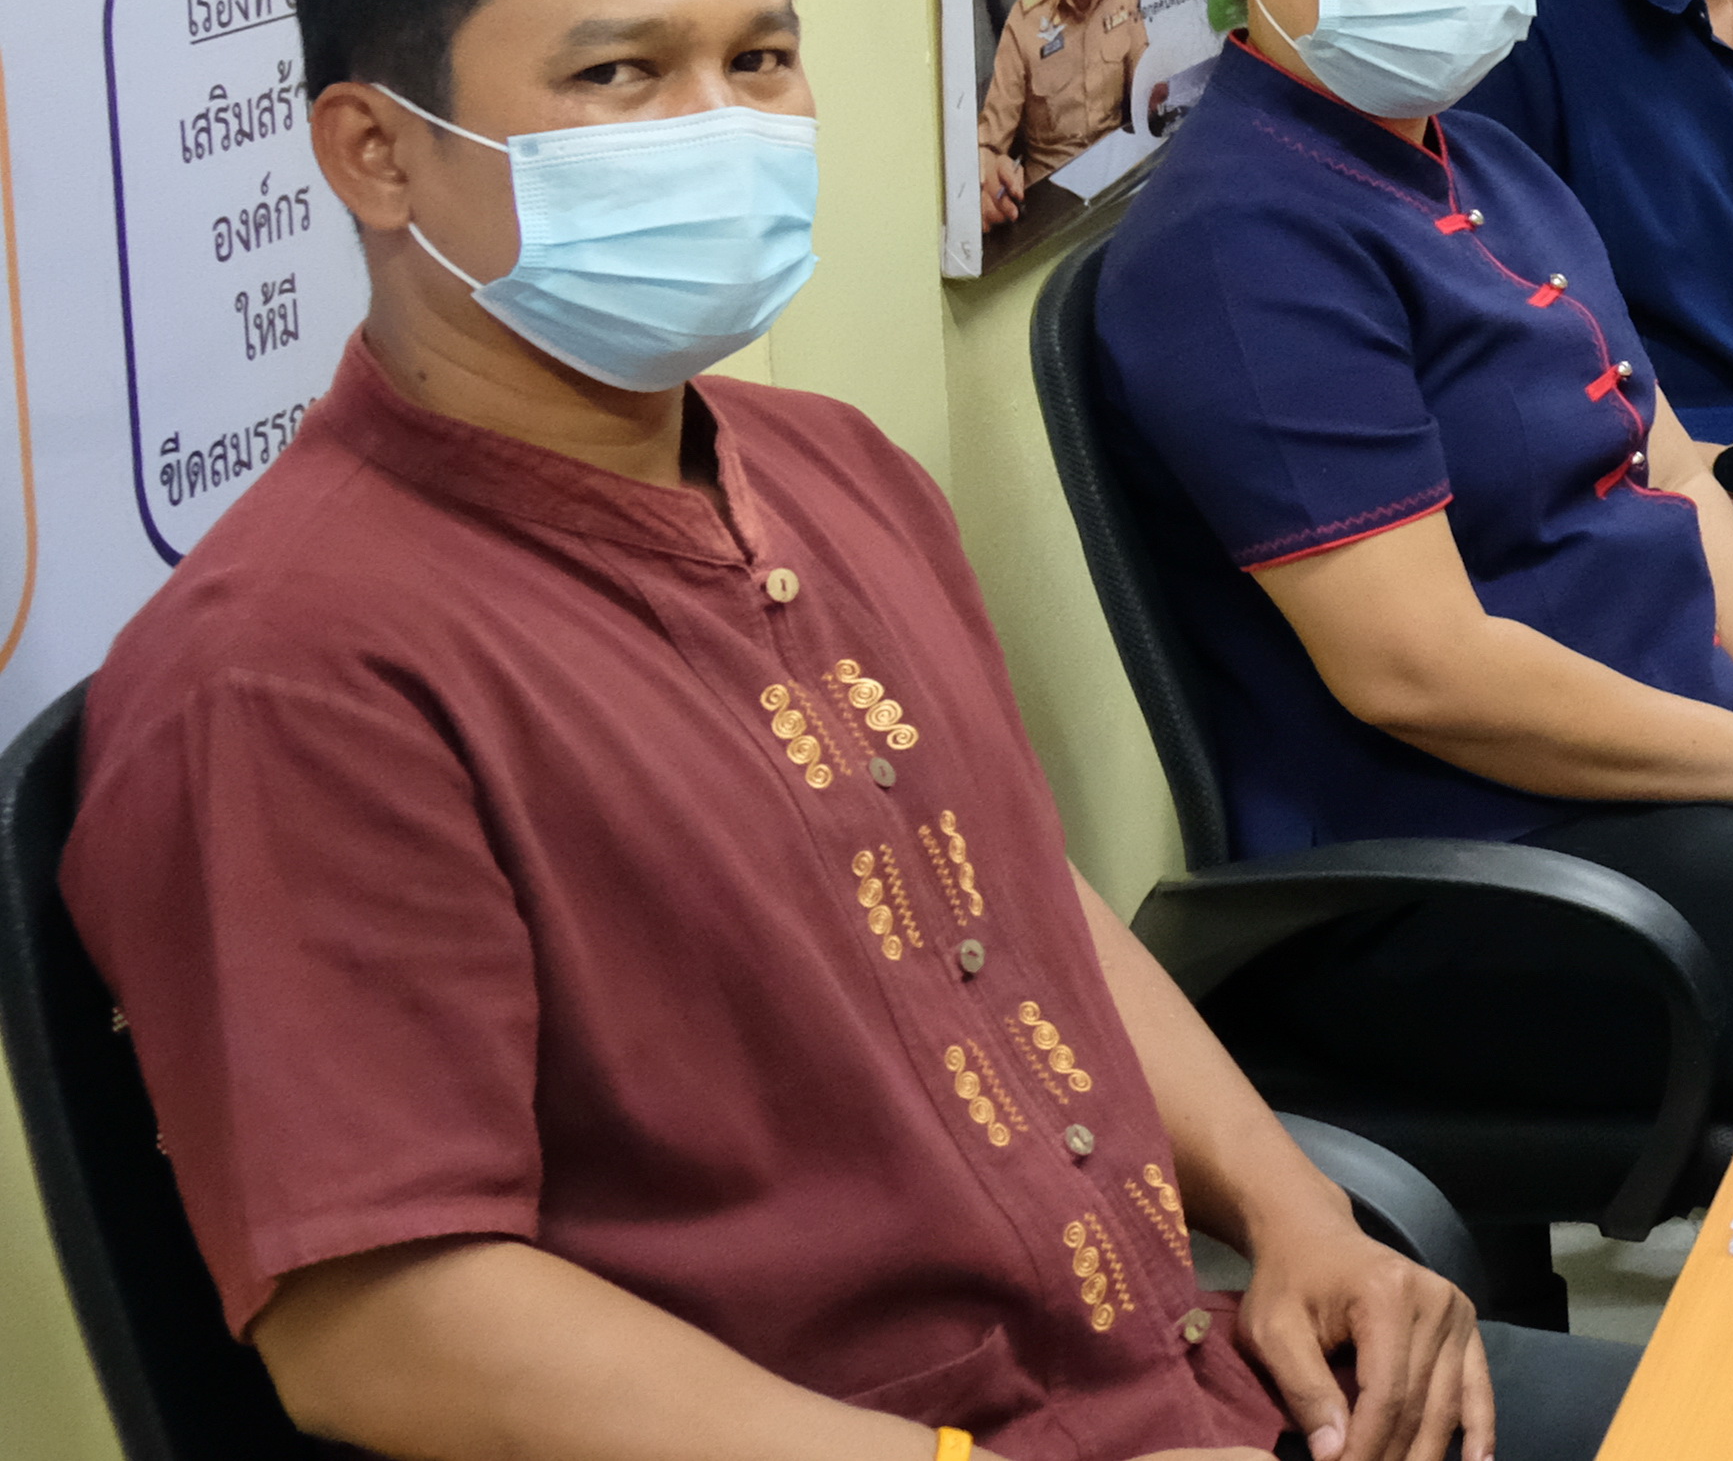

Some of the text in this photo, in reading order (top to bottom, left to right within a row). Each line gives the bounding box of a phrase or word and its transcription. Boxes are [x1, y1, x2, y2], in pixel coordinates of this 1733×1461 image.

[212, 172, 311, 263] องค์กร
[236, 272, 300, 362] ให้มี
